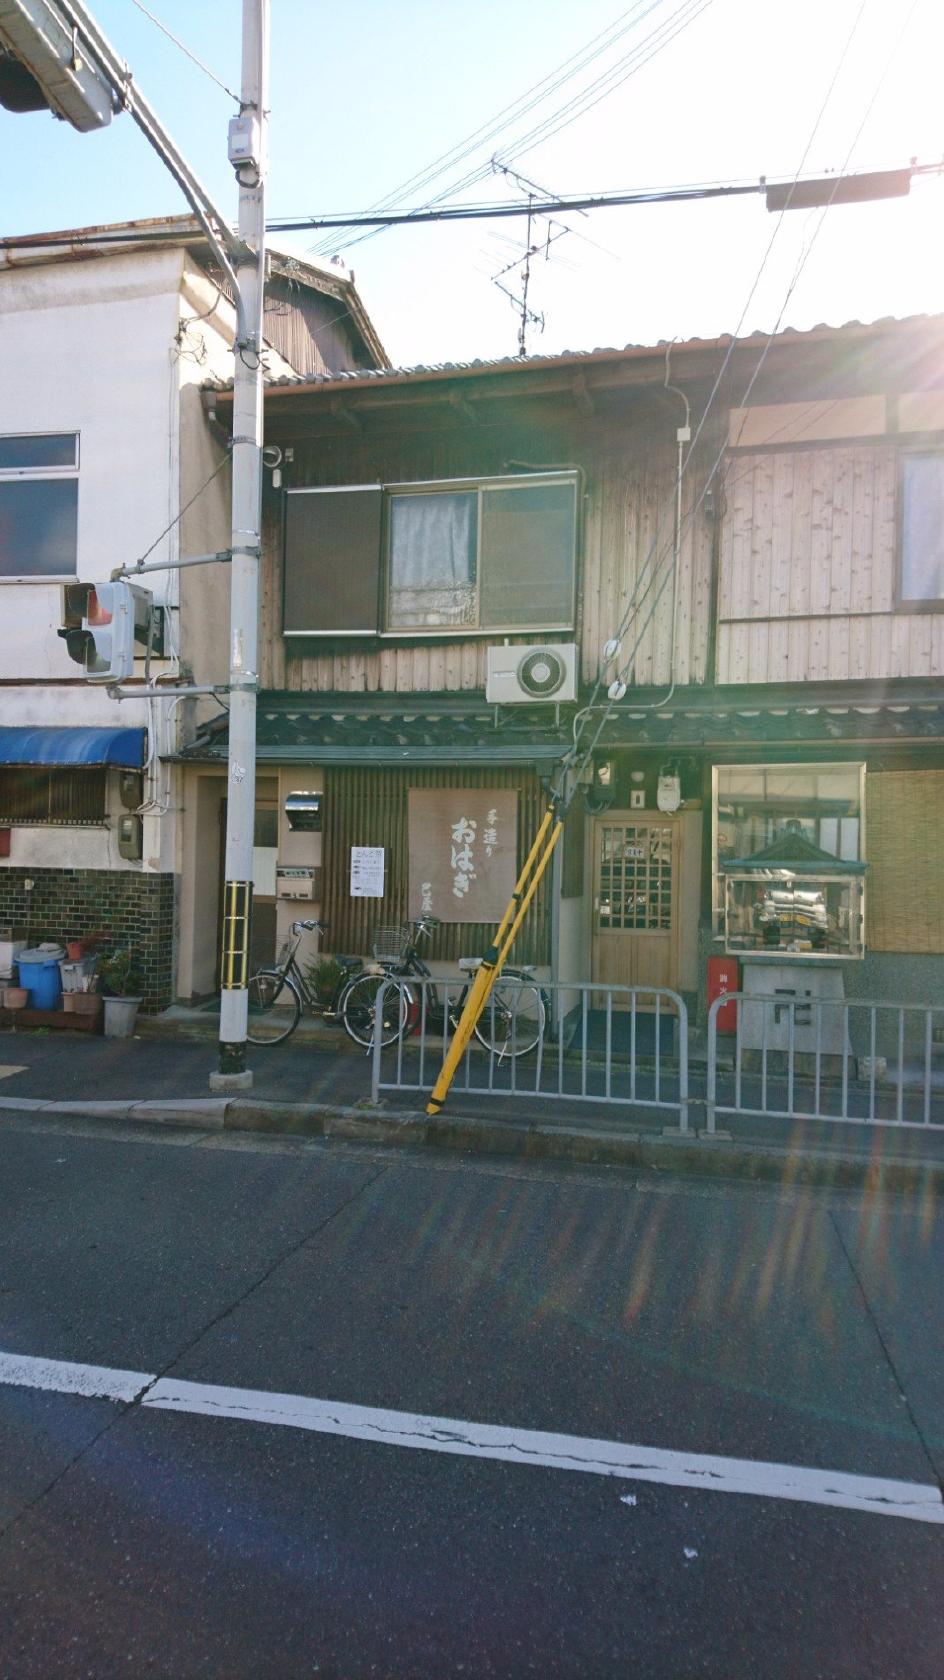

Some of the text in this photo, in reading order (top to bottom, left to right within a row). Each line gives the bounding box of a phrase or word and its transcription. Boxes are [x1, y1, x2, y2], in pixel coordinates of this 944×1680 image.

[450, 816, 477, 898] おはぎ
[483, 808, 498, 858] 手造り
